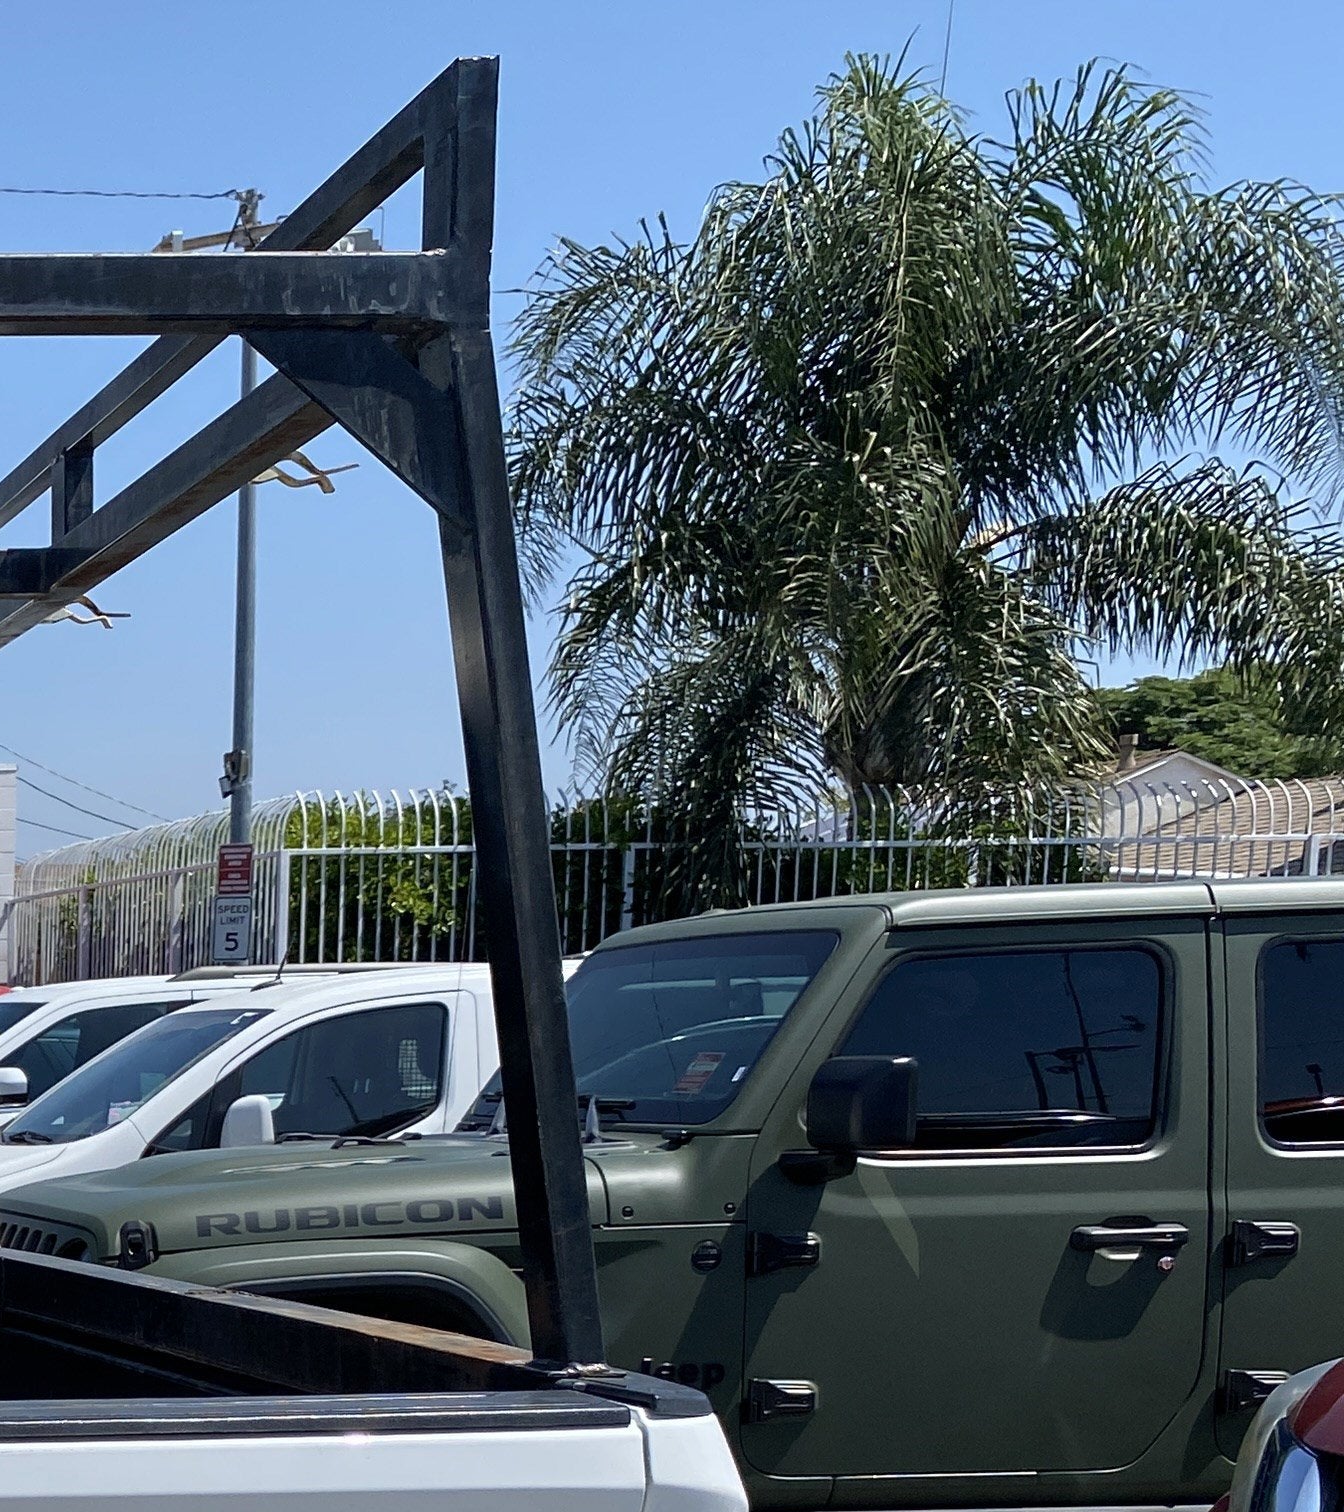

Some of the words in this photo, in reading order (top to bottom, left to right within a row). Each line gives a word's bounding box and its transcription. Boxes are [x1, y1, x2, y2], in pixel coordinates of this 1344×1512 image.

[217, 904, 249, 914] SPEED
[220, 916, 246, 925] LIMIT
[224, 932, 239, 952] 5
[195, 1195, 504, 1238] RUBICON
